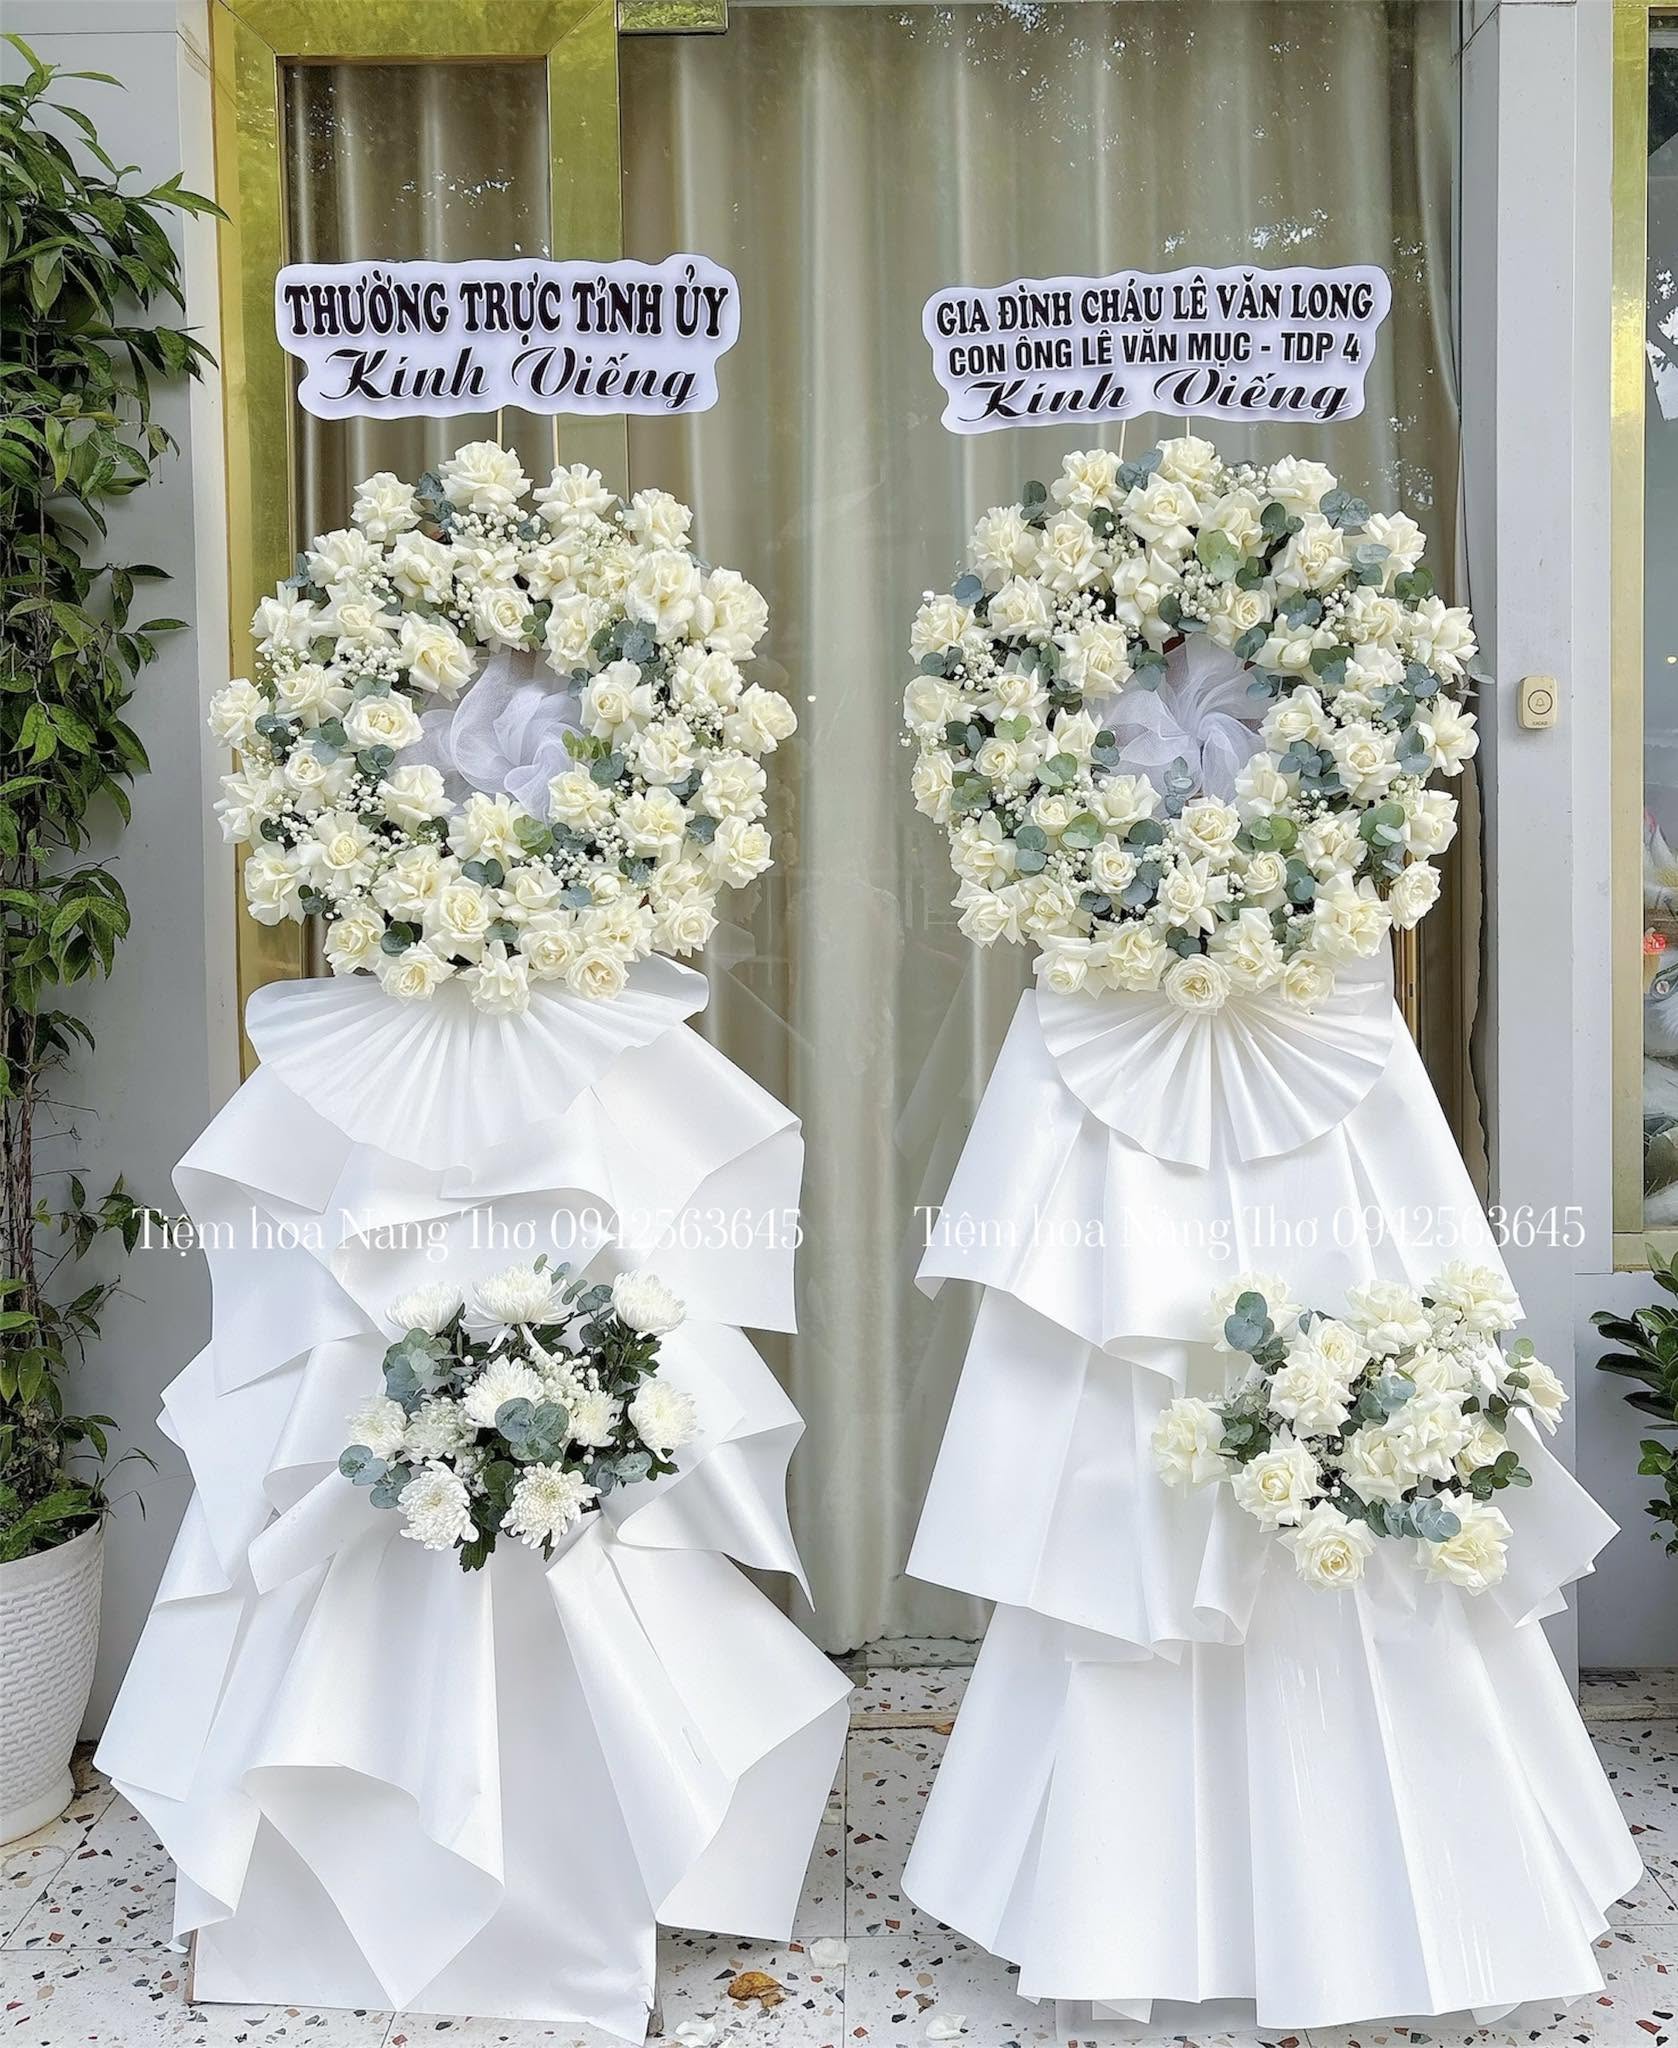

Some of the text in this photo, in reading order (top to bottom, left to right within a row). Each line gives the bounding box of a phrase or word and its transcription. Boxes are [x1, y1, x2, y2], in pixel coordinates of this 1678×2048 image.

[284, 269, 449, 336] THƯỜNG
[460, 273, 562, 346] TRỰC
[674, 264, 729, 338] ỦY
[936, 273, 1374, 336] GIA ĐÌNH CHÁU LÊ VĂN LONG
[318, 346, 699, 408] Kính Viếng
[948, 329, 1360, 376] CON ÔNG LÊ VĂN MỤC - TDP 4
[957, 368, 1352, 422] Kính Viếng
